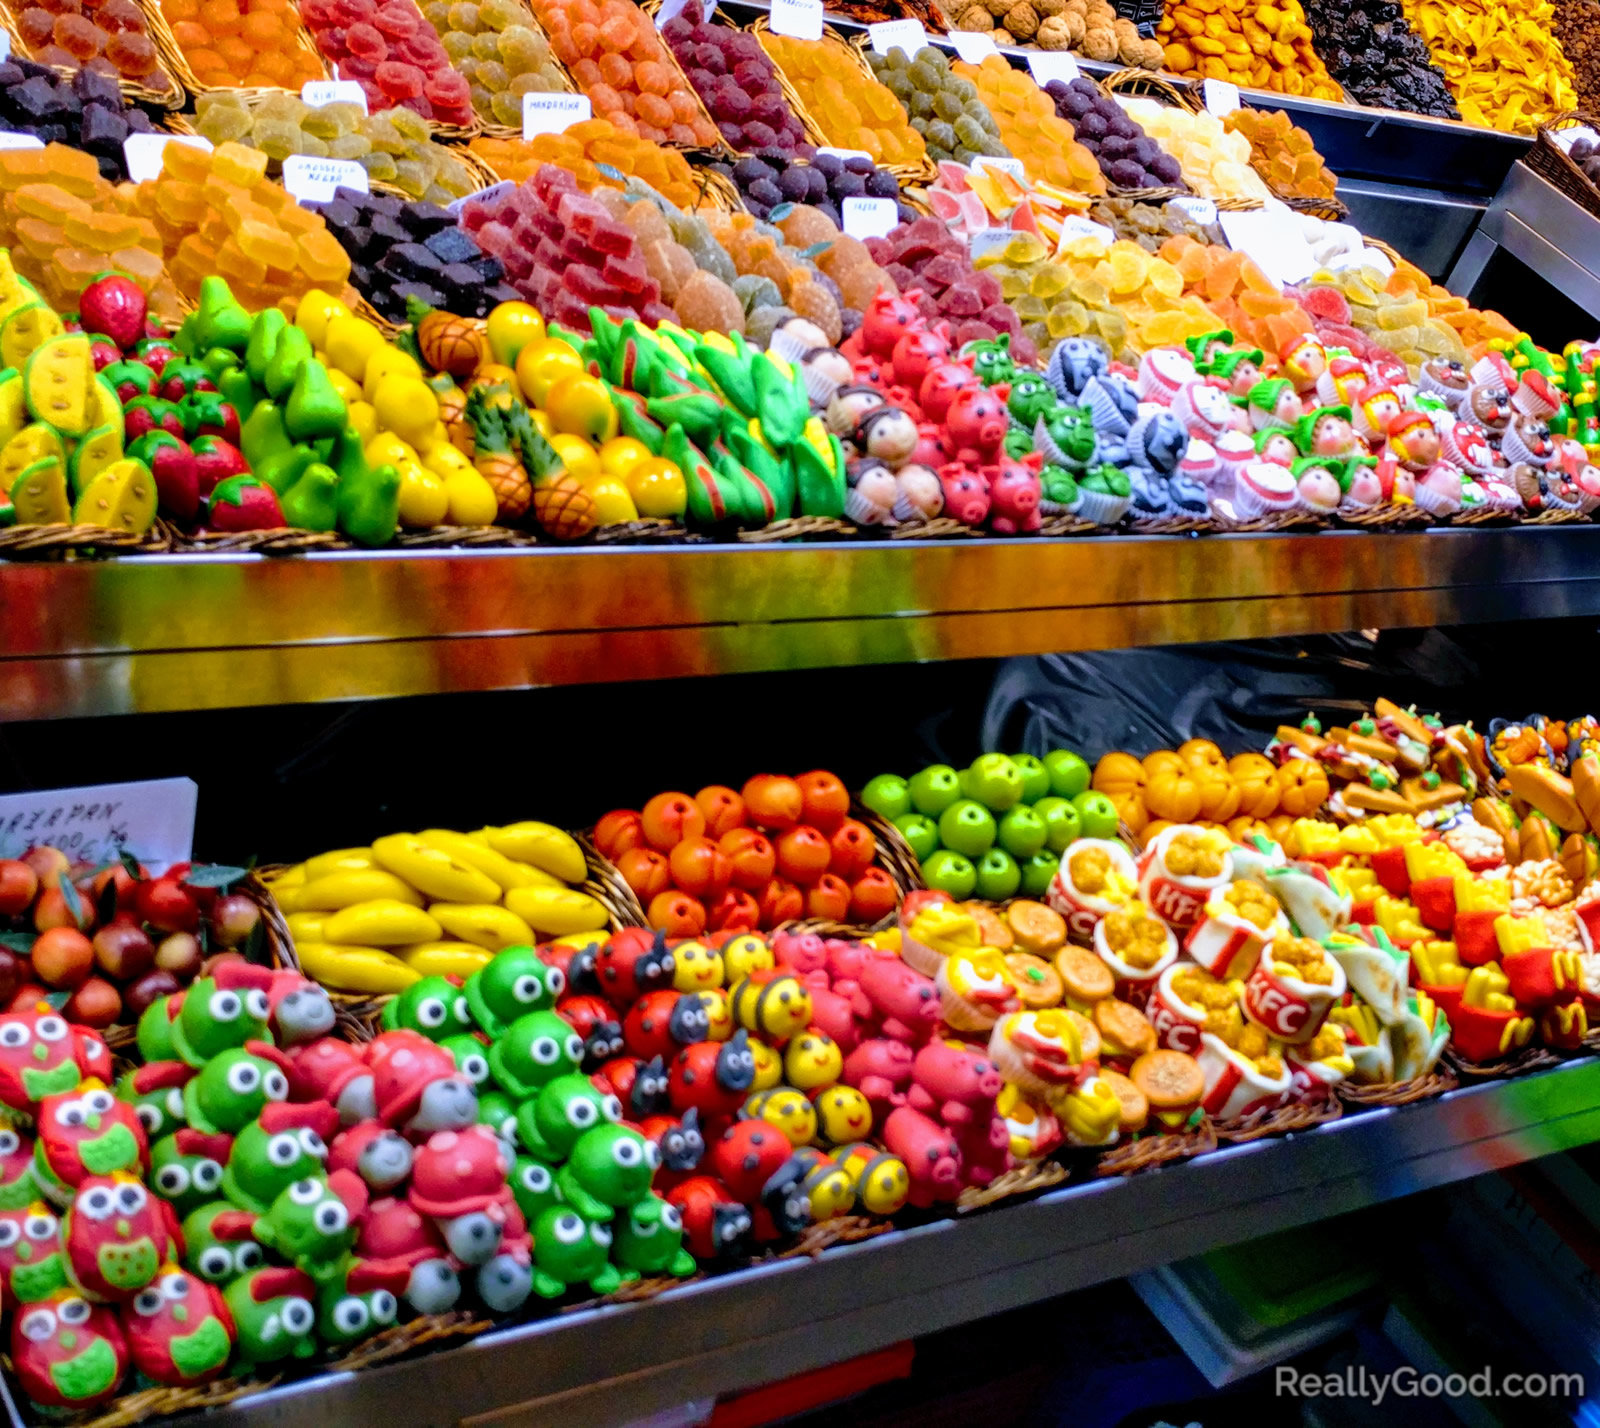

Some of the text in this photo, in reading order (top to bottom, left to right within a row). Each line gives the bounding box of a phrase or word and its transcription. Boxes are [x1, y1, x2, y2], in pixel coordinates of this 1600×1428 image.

[529, 99, 580, 110] MANDARINA
[1144, 993, 1197, 1052] KFC
[1249, 971, 1307, 1034] KFC
